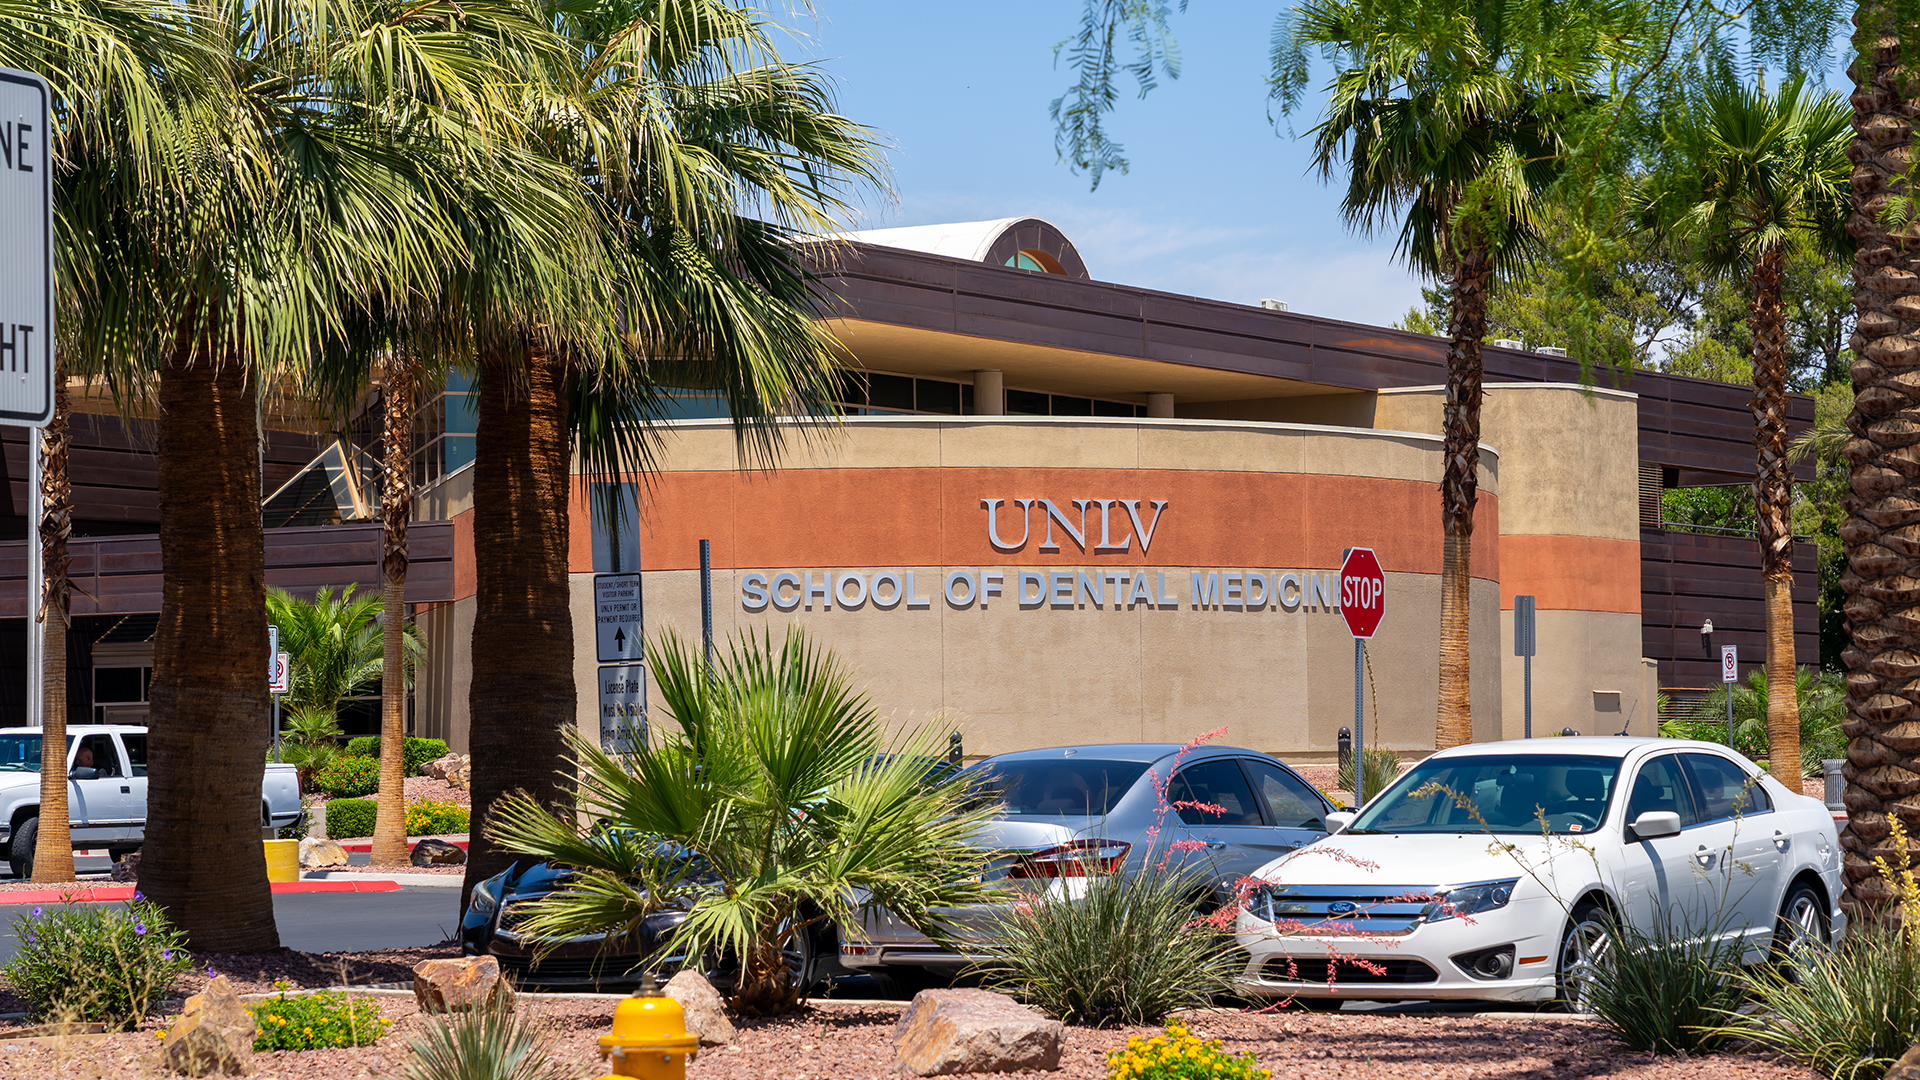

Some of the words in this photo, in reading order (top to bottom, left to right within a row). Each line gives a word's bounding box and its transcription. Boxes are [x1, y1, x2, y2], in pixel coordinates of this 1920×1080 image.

[980, 498, 1169, 554] UNLV
[741, 571, 930, 608] SCHOOL
[945, 571, 1004, 606] OF
[1019, 571, 1179, 606] DENTAL
[1343, 575, 1382, 609] STOP
[597, 615, 618, 623] PAYMENT
[614, 603, 629, 612] PERMIT
[631, 603, 637, 611] OR
[605, 680, 624, 694] License
[626, 679, 639, 693] Plate
